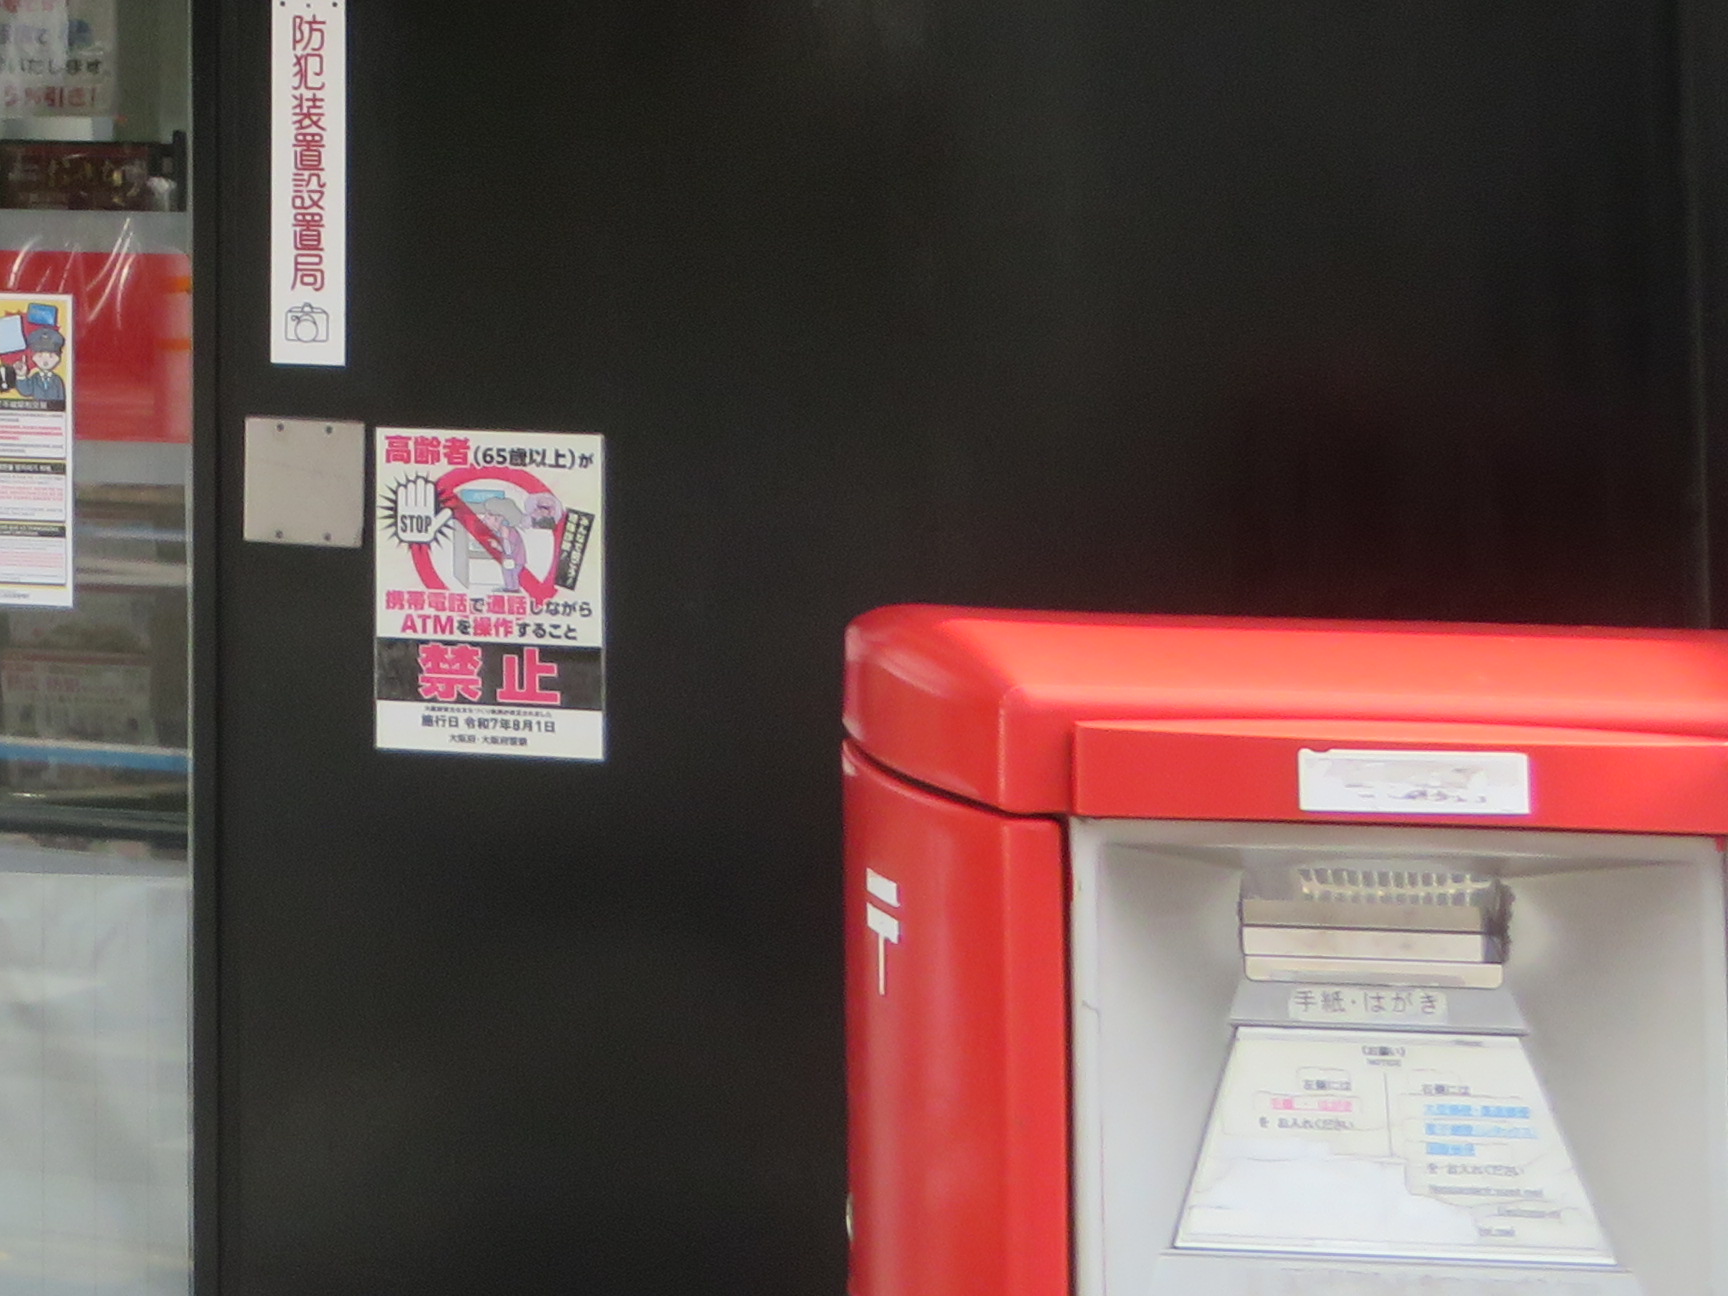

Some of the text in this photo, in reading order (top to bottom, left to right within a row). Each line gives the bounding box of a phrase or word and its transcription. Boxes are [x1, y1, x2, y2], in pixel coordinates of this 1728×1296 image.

[290, 13, 327, 293] 防犯装置設置局
[383, 433, 594, 470] 高齢者(65歳以上)が
[399, 512, 432, 534] STOP
[385, 590, 593, 618] 携帯電話で通話しながら
[400, 614, 578, 641] ATMを操作すること
[417, 642, 561, 705] 禁止
[421, 714, 556, 734] 施行日 令和7年8月1日
[1293, 989, 1440, 1015] 手紙・はがき
